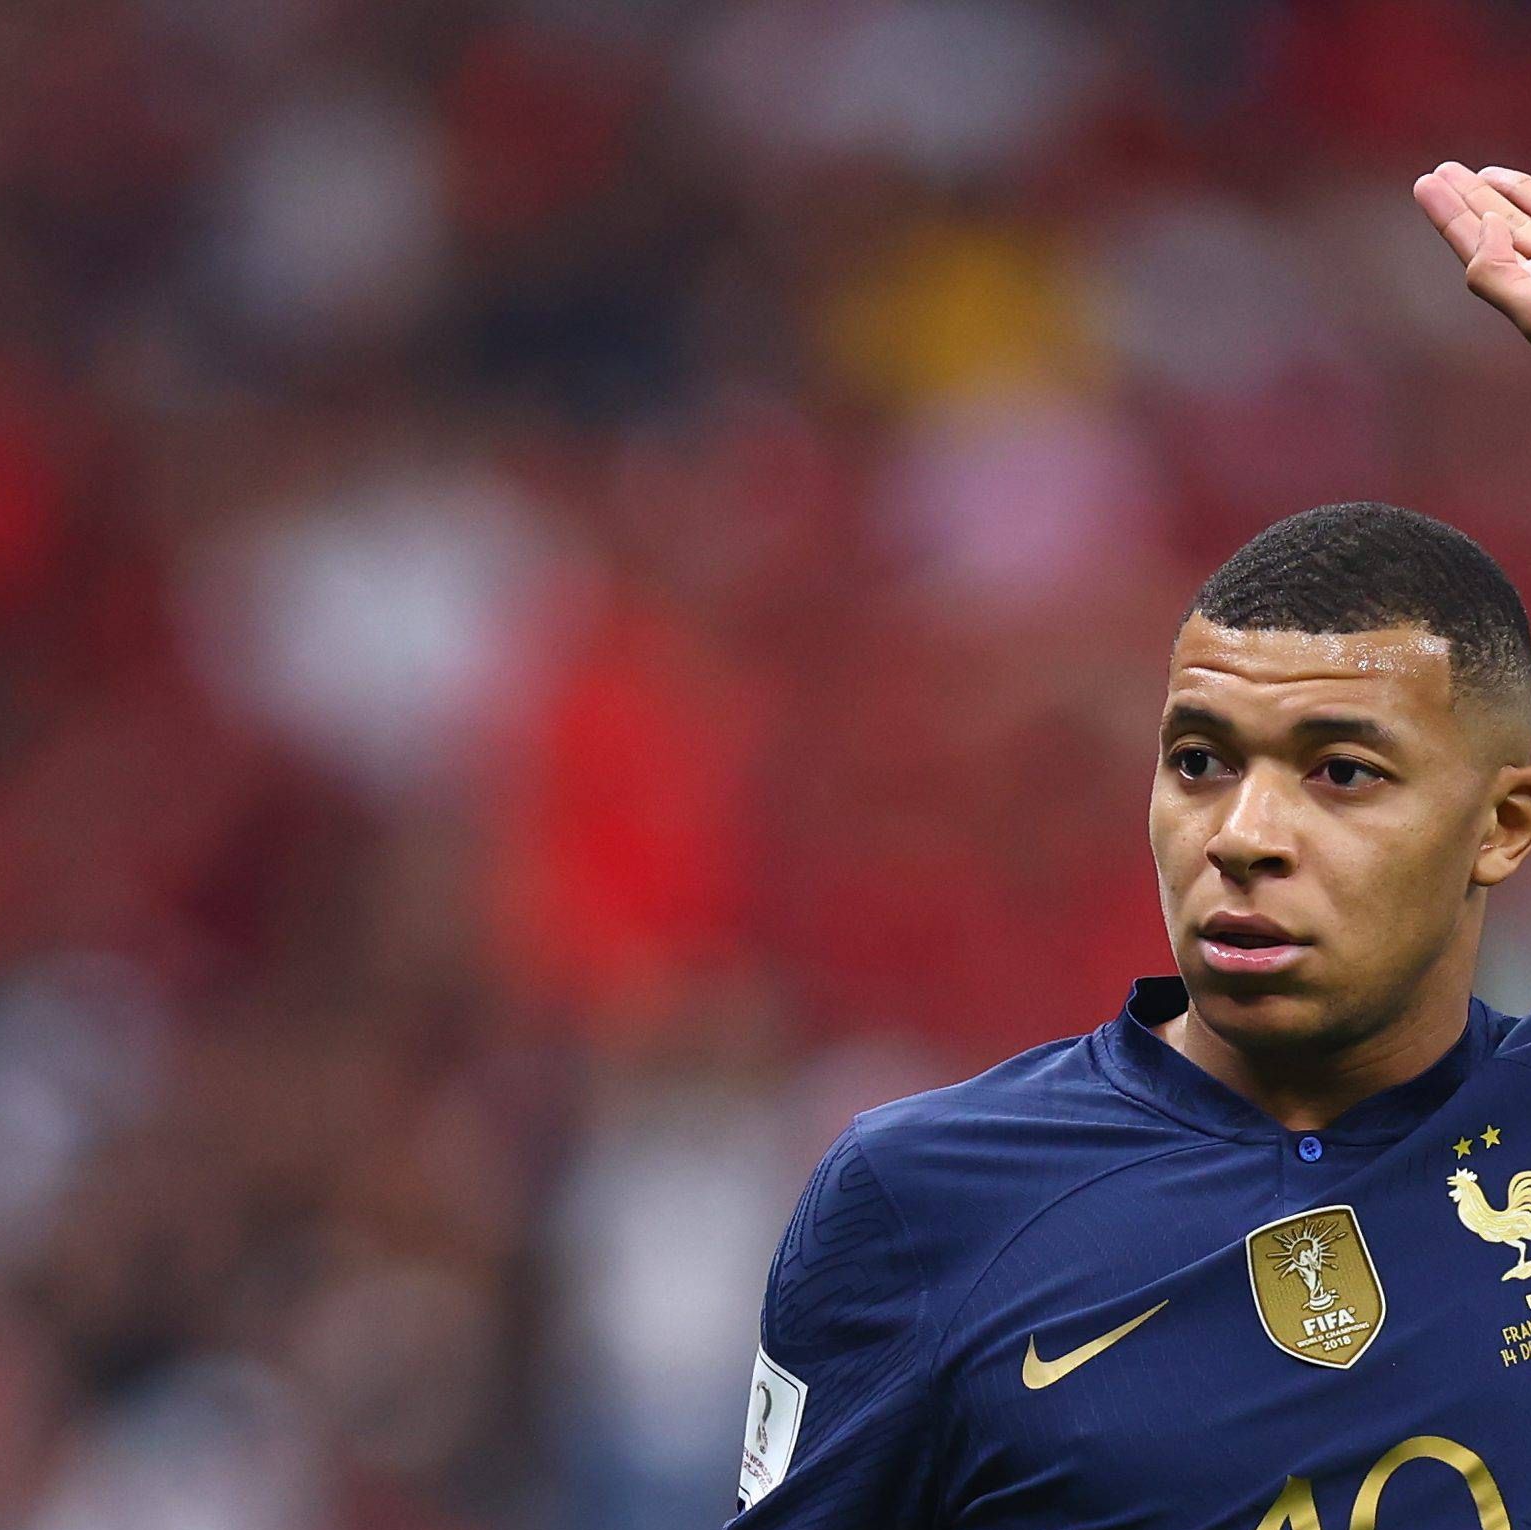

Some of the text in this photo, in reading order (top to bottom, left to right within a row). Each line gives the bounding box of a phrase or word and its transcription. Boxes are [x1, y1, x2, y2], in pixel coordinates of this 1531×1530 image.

[1302, 1308, 1356, 1337] FIFA
[1295, 1321, 1370, 1349] WORLD CHAMPIONS
[1323, 1335, 1352, 1352] 2018
[1500, 1348, 1518, 1368] 14
